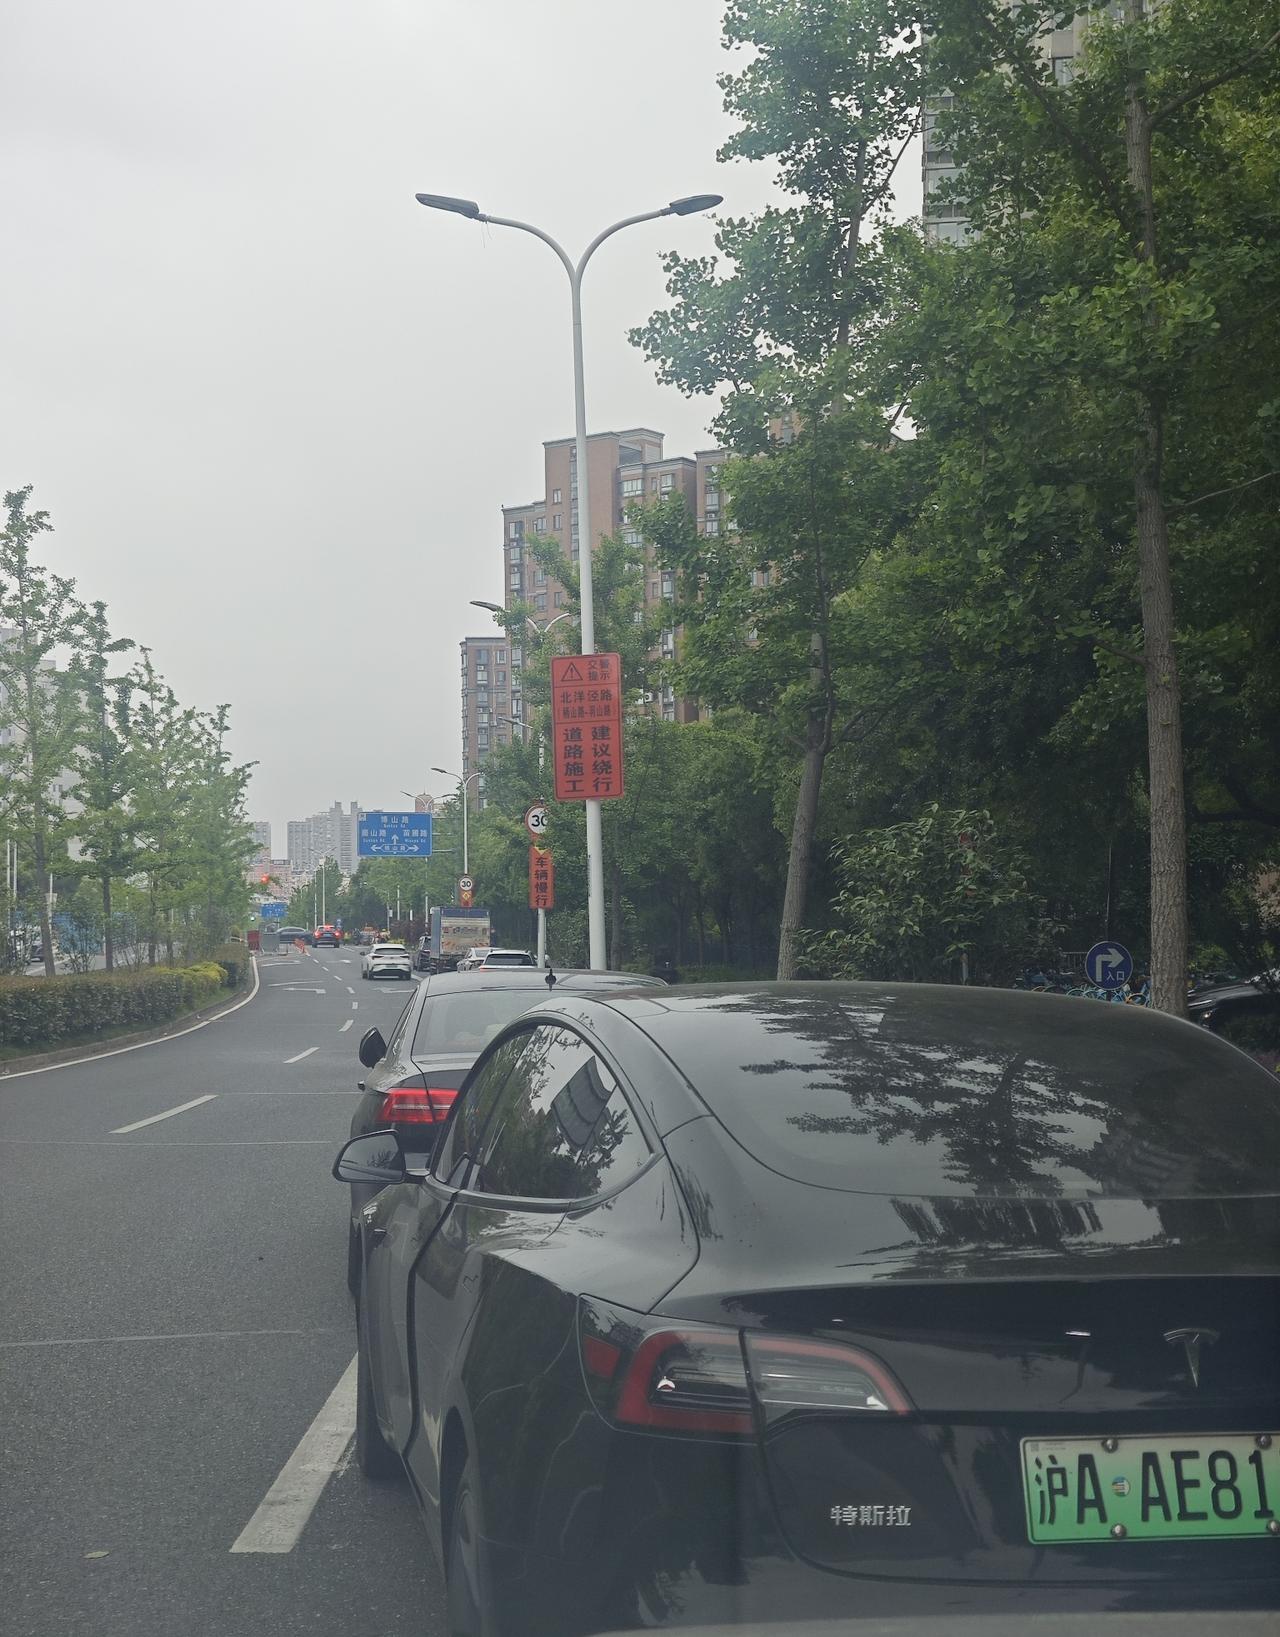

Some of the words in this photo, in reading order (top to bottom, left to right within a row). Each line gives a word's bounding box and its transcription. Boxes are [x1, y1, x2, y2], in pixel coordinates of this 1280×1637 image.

[588, 659, 610, 670] 交警
[588, 670, 611, 681] 提示
[563, 727, 585, 793] 道路施工
[591, 725, 613, 793] 建议绕行
[461, 880, 472, 888] 30
[535, 857, 548, 906] 车辆慢行
[1106, 970, 1125, 981] 入口
[1140, 1449, 1280, 1523] AE81
[830, 1505, 912, 1526] 特斯拉
